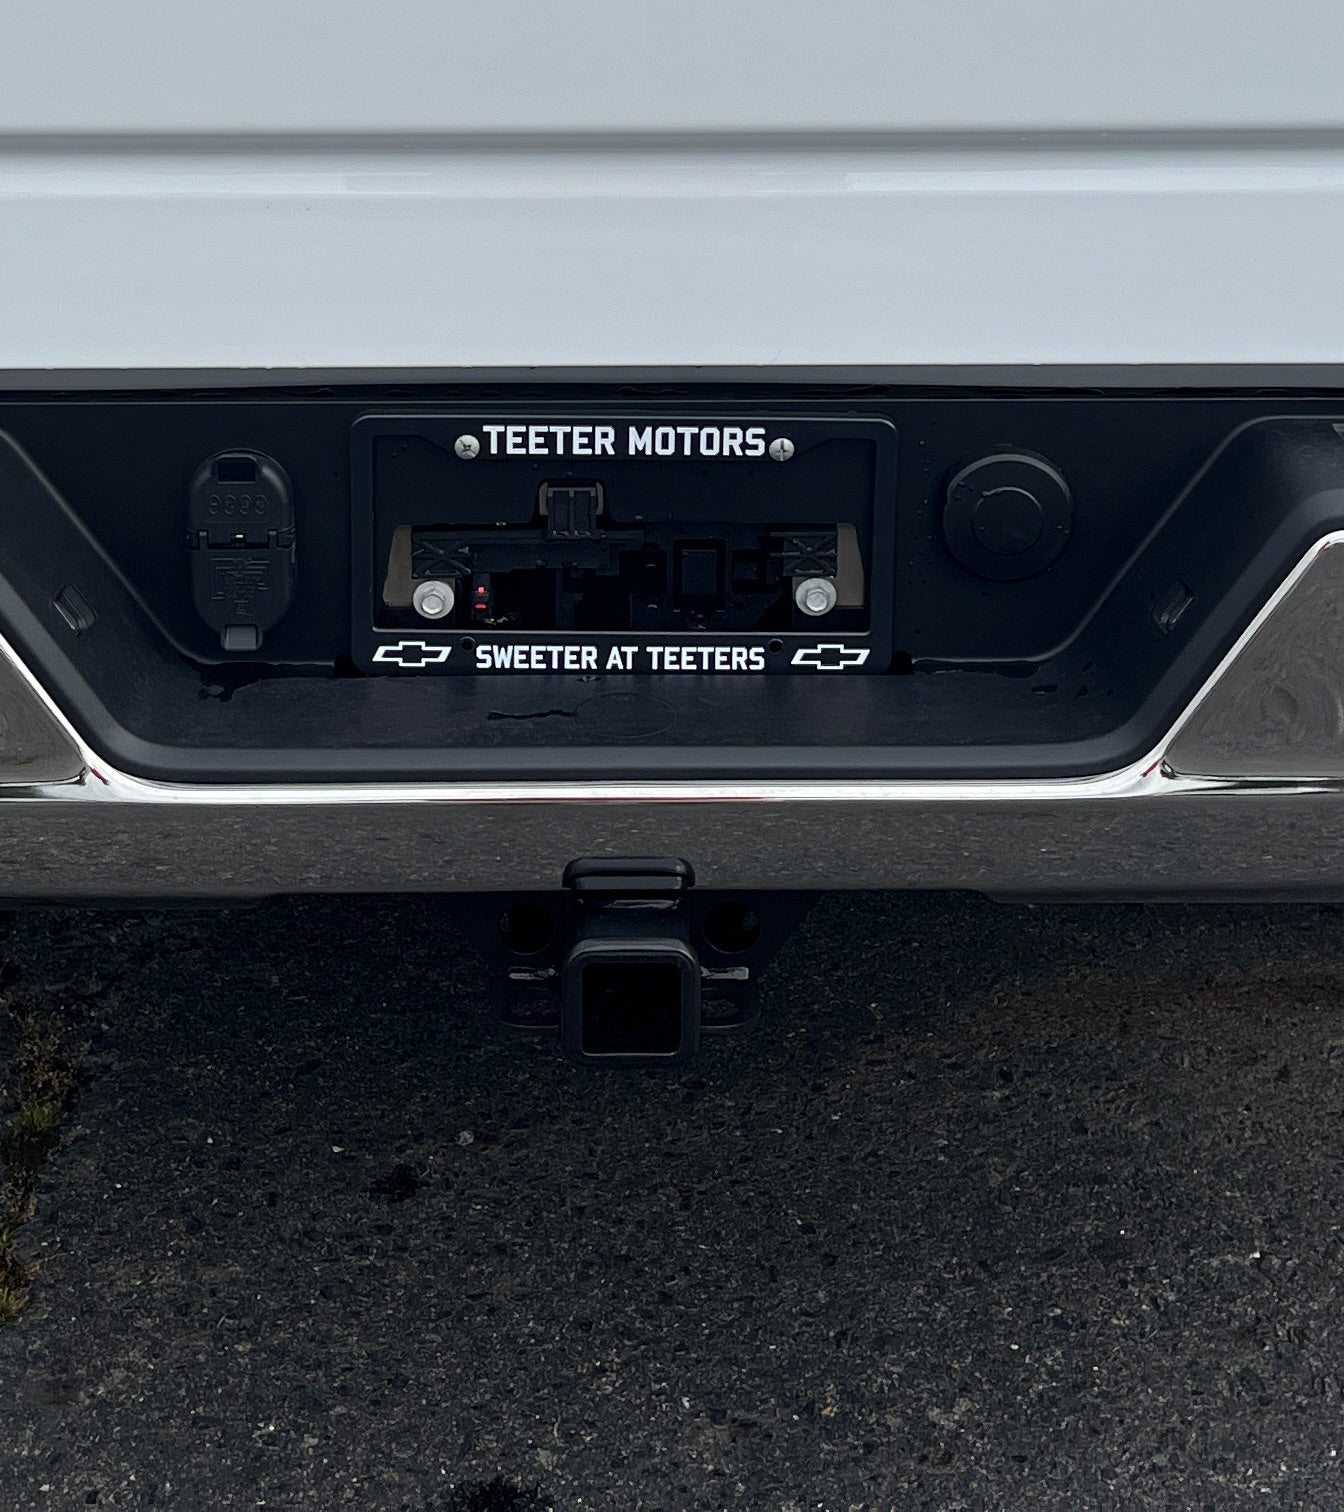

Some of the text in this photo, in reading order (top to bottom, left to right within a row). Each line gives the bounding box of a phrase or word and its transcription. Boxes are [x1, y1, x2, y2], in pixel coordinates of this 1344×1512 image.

[482, 425, 766, 457] TEETER MOTORS
[475, 644, 765, 671] SWEETER AT TEETERS
